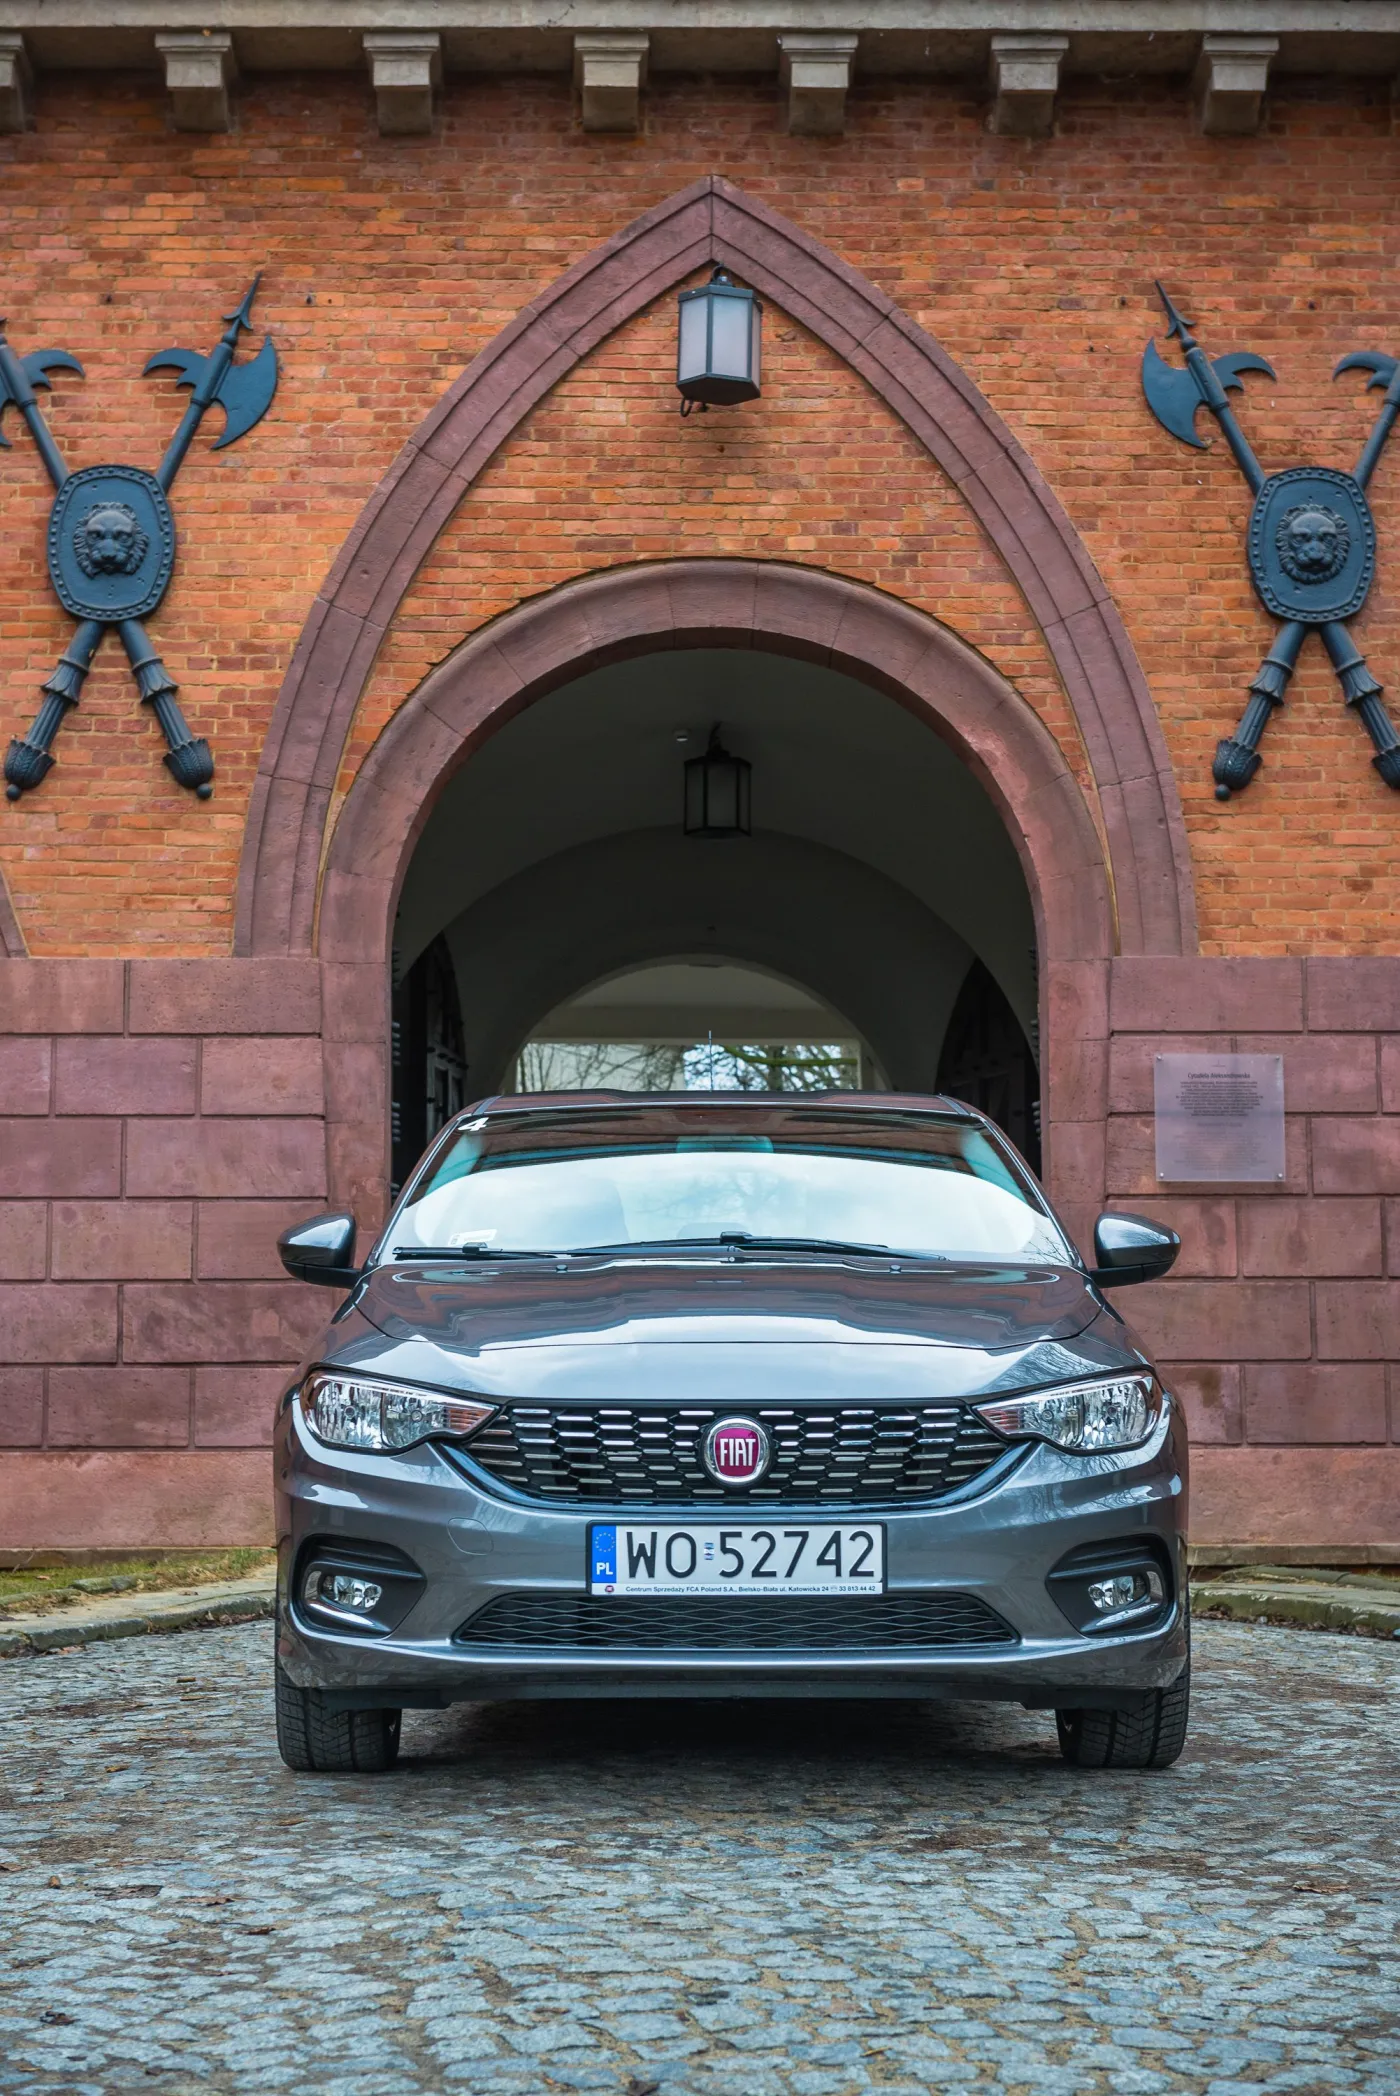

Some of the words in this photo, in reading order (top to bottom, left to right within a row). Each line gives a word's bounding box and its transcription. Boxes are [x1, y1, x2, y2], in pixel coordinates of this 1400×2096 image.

[719, 1438, 756, 1466] FIAT
[596, 1562, 613, 1575] PL
[626, 1531, 697, 1579] WO
[719, 1530, 874, 1578] 52742
